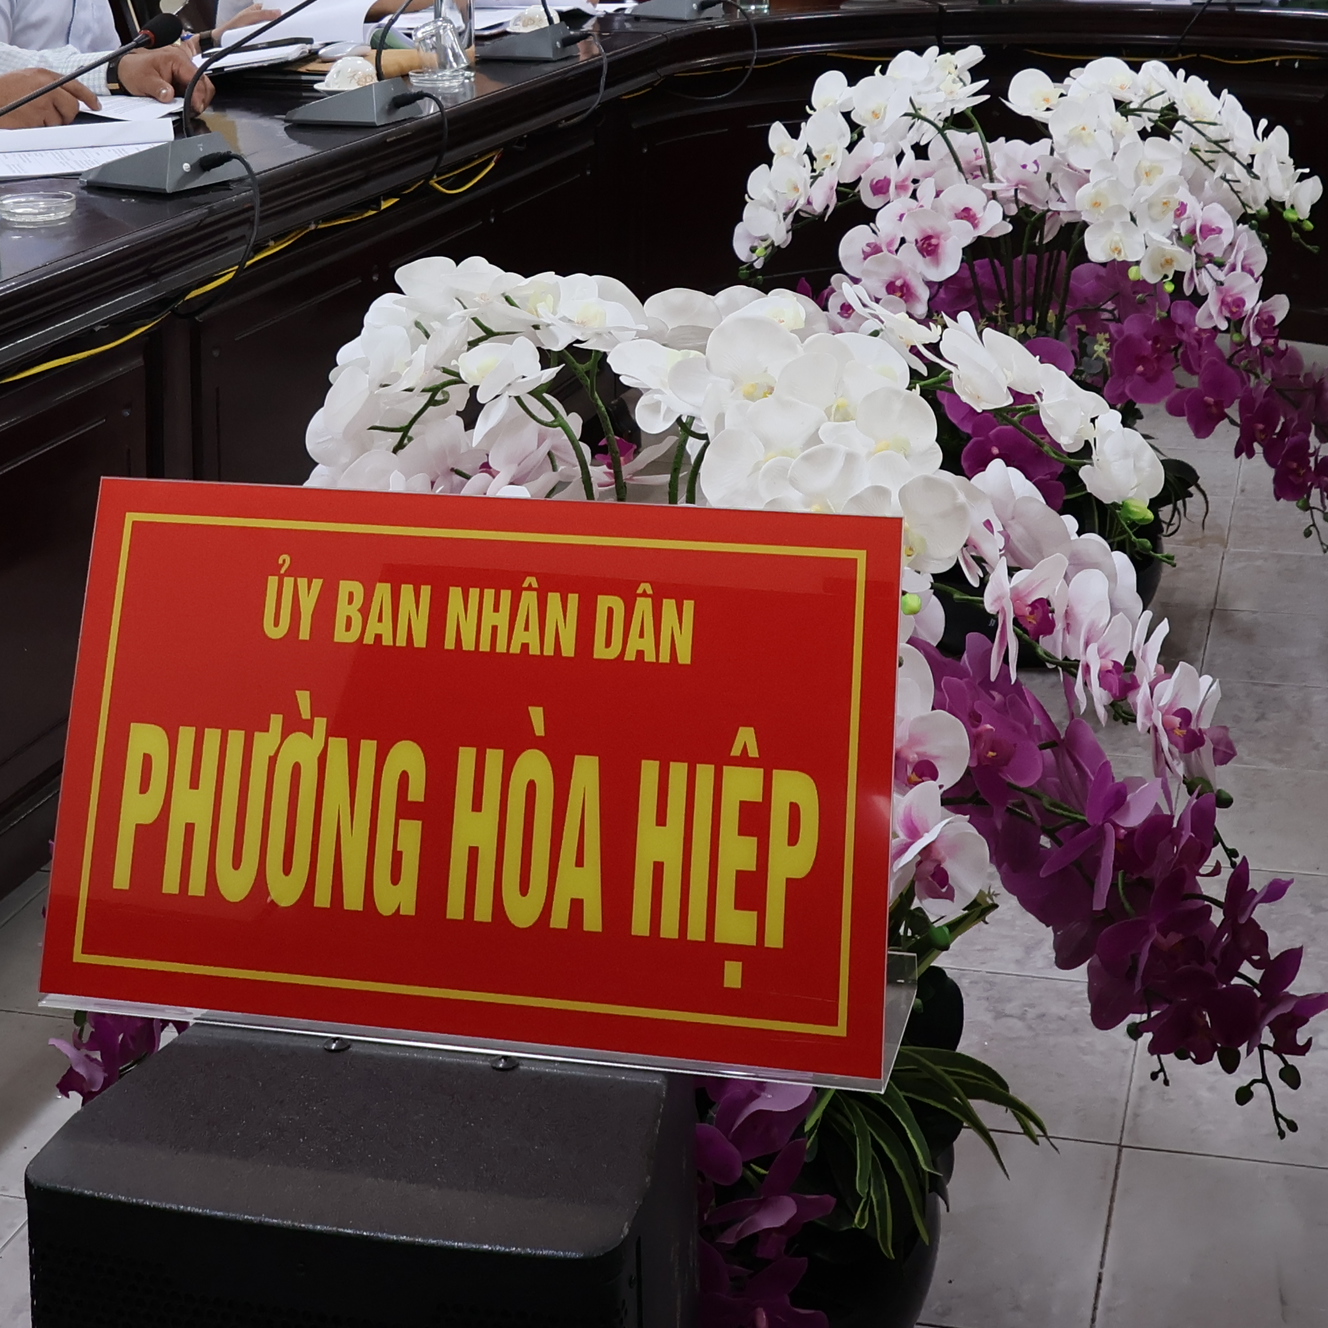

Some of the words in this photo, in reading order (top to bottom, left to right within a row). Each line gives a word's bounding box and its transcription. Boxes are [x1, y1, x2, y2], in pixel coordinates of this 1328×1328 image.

[264, 555, 322, 638] ỦY
[334, 580, 430, 647] BAN
[445, 578, 578, 656] NHÂN
[594, 583, 693, 663] DÂN
[113, 691, 425, 915] PHƯỜNG
[447, 707, 601, 931] HÒA
[632, 727, 818, 987] HIỆP
